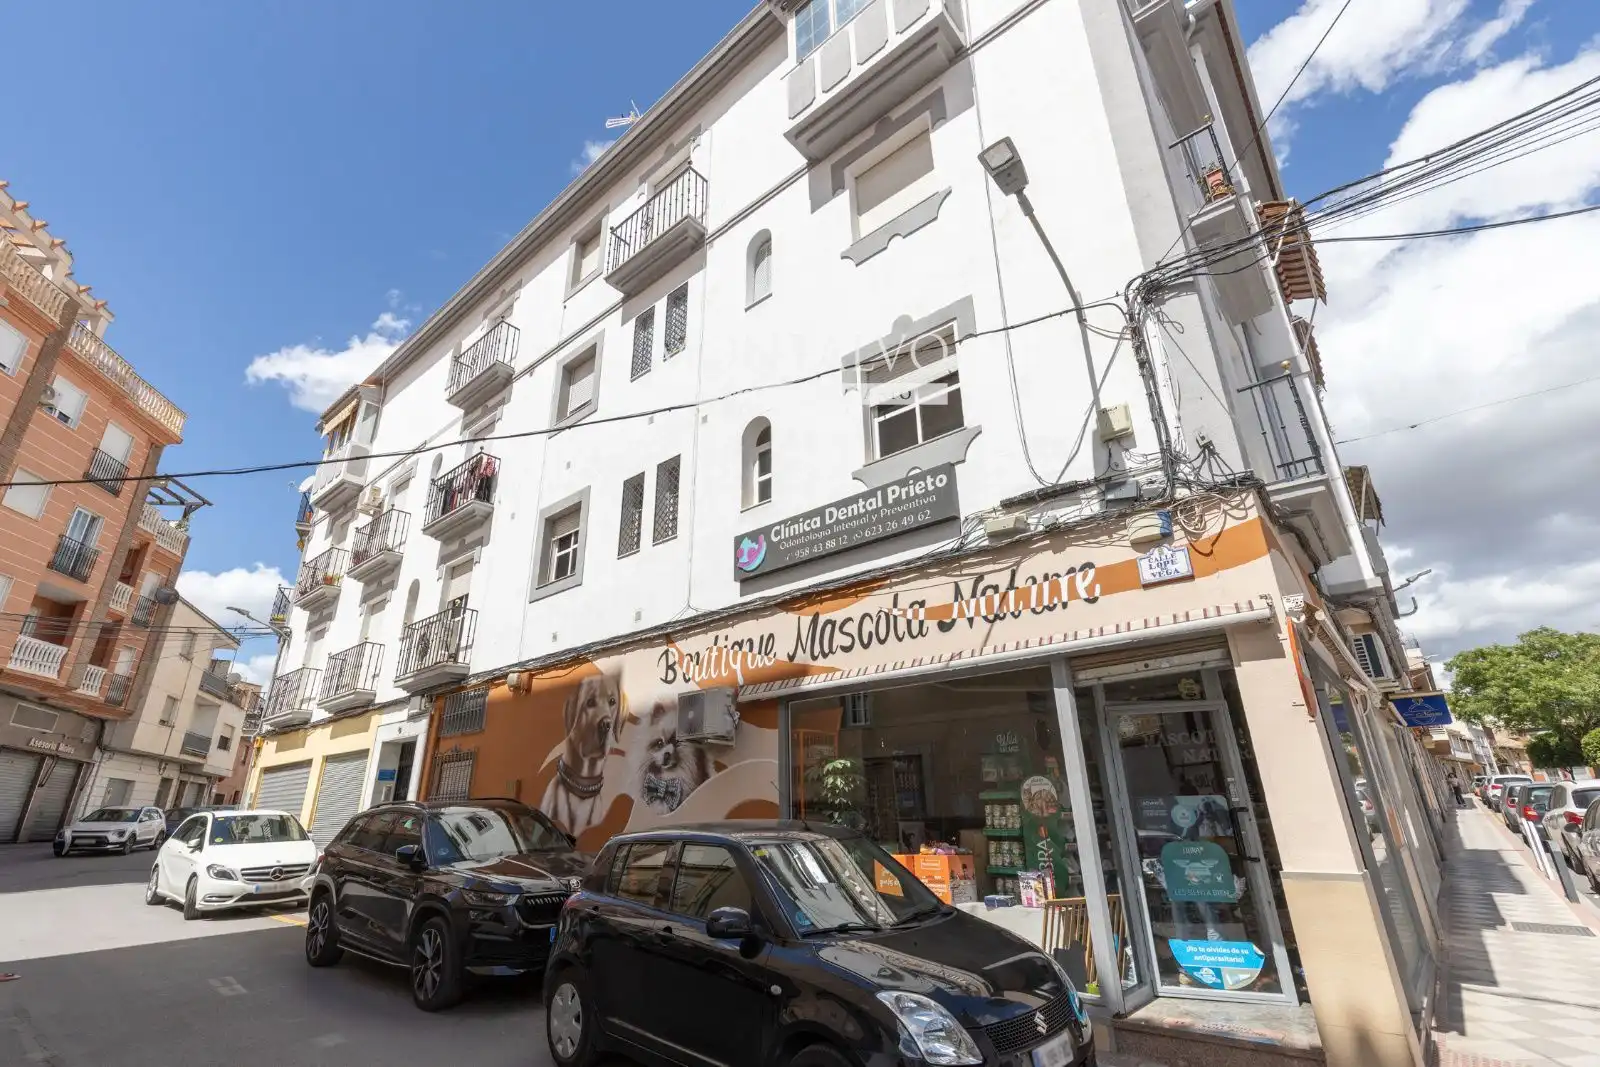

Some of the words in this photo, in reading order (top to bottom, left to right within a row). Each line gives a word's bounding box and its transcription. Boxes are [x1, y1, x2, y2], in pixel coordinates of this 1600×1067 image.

[770, 516, 821, 542] Clínica
[825, 490, 883, 525] Dental
[887, 473, 948, 504] Prieto
[833, 514, 869, 533] Integral
[871, 513, 878, 523] y
[880, 494, 937, 518] Preventiva
[794, 546, 810, 560] 958
[812, 542, 823, 553] 43
[825, 538, 836, 550] 88
[839, 534, 848, 545] 12
[865, 524, 883, 538] 623
[885, 519, 898, 532] 26
[901, 514, 914, 527] 49
[917, 509, 932, 522] 62
[1148, 552, 1177, 564] CALLE
[1149, 559, 1177, 570] LOPE
[1151, 567, 1180, 578] VEGA
[657, 632, 777, 687] Boutique
[787, 592, 929, 663] Mascota
[937, 561, 1101, 633] Nature
[1144, 729, 1217, 748] MASCOT
